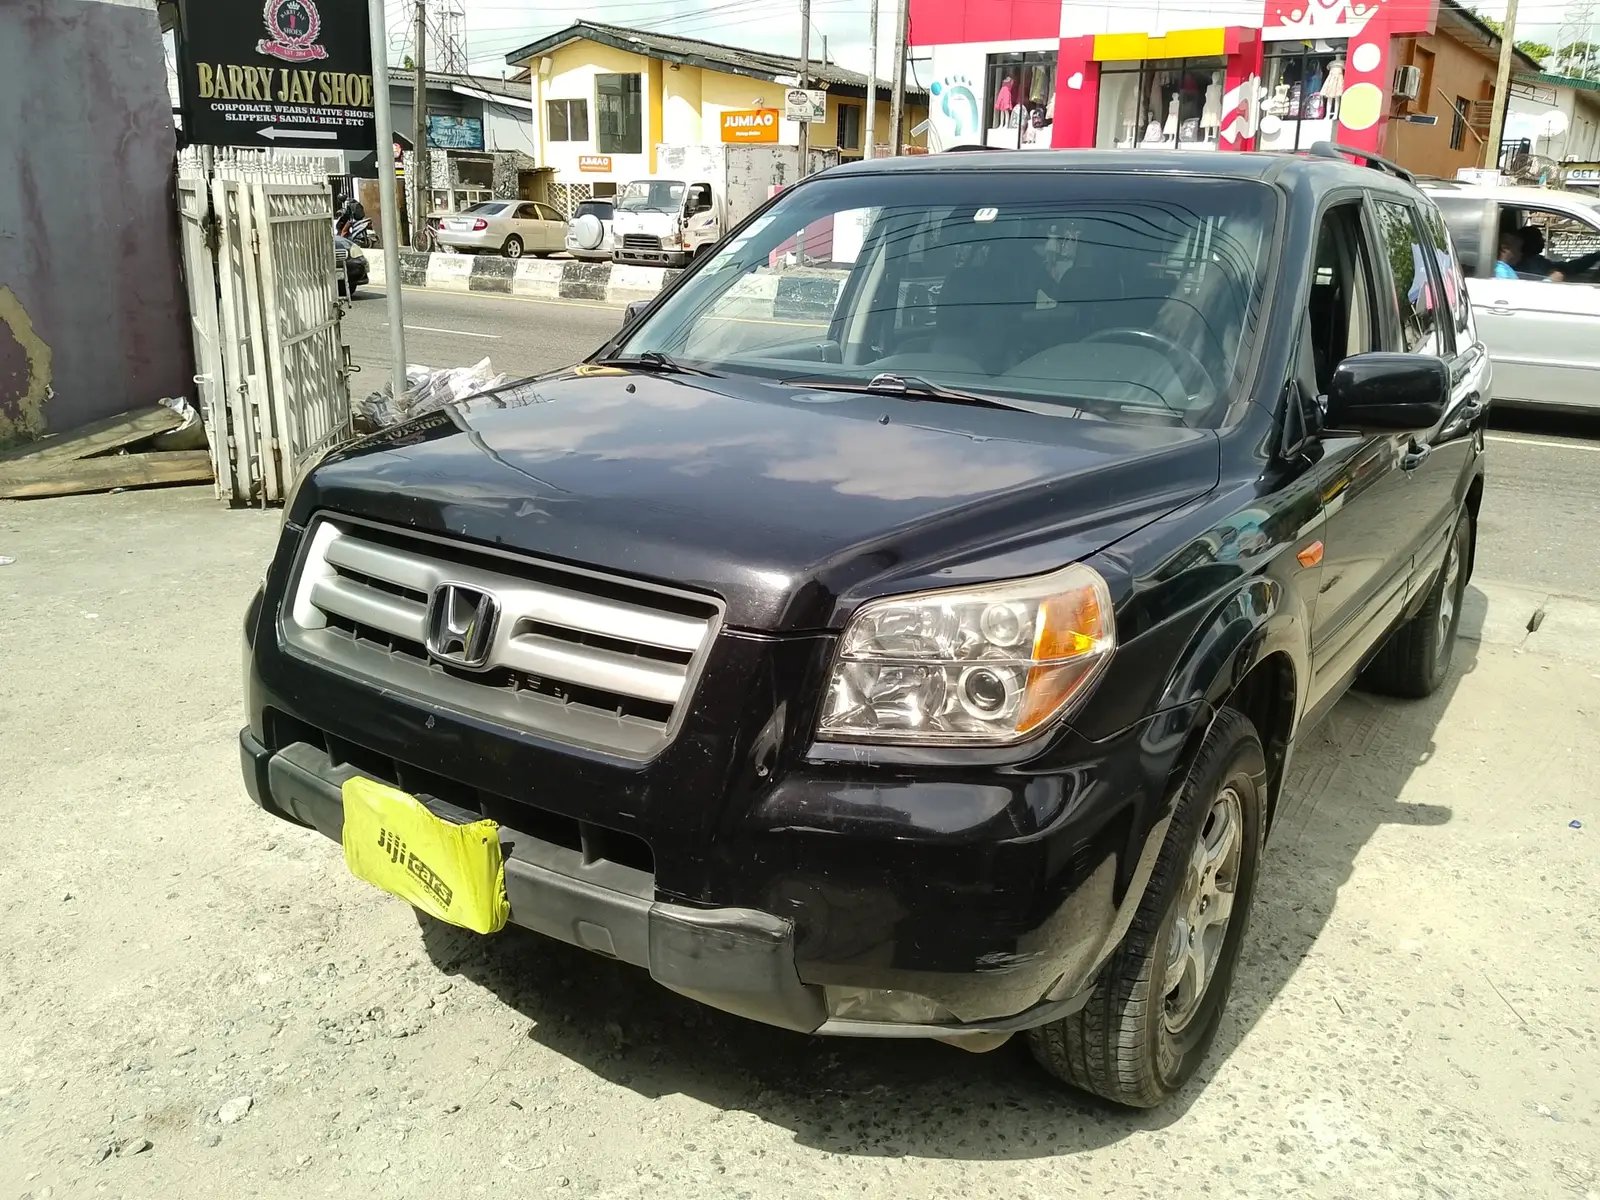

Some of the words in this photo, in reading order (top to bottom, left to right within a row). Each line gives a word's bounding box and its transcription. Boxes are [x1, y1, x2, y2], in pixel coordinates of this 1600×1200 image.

[283, 27, 302, 35] SHOES
[196, 62, 275, 101] BARRY
[277, 68, 317, 104] JAY
[319, 71, 374, 107] SHOE
[210, 103, 272, 112] CORPORATE
[274, 105, 308, 115] WEARS
[309, 107, 343, 117] NATIVE
[344, 109, 374, 119] SHOES
[225, 113, 276, 122] SLIPPERS
[279, 115, 318, 124] SANDAL
[319, 117, 344, 125] BELT
[345, 118, 365, 127] ETC
[1572, 169, 1594, 179] GET
[377, 827, 406, 865] jiji
[411, 859, 451, 902] cars
